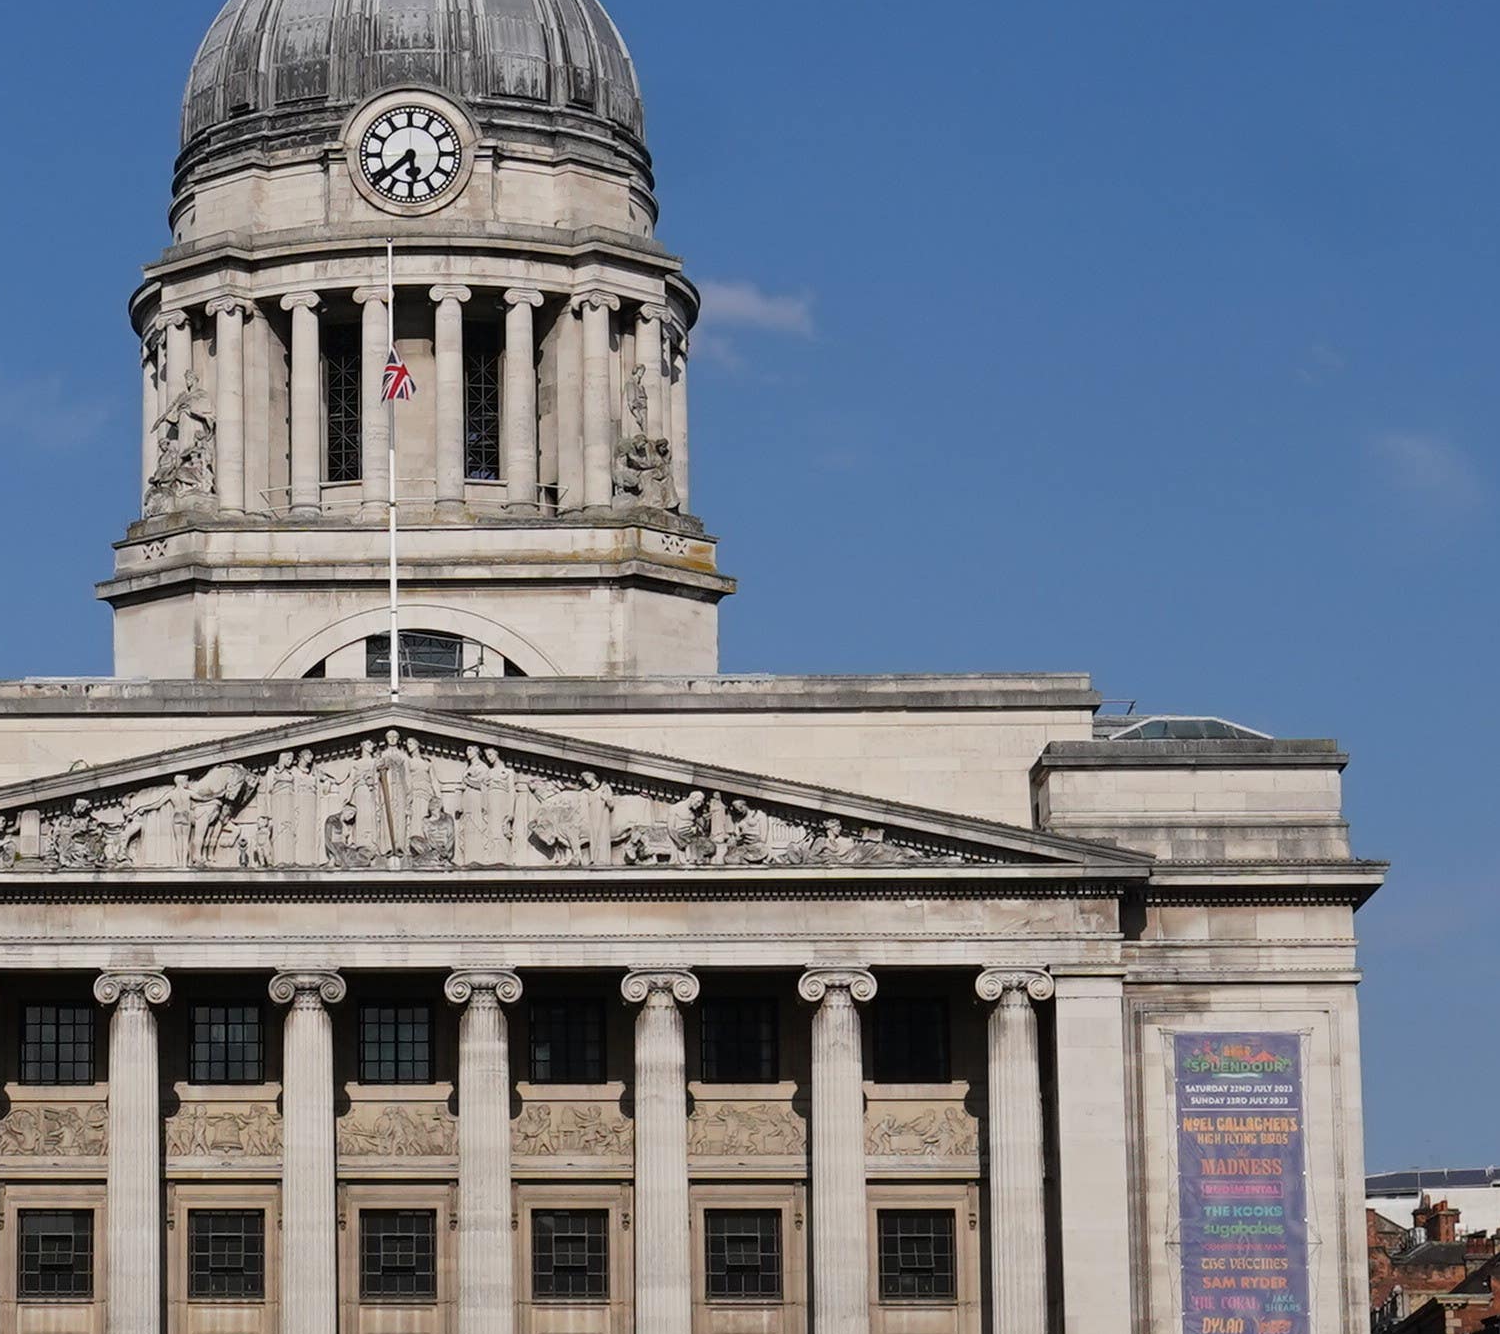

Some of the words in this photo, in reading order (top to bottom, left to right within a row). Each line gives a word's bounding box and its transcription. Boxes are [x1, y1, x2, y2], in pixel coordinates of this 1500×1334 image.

[1190, 1061, 1285, 1073] SPLENDOUR
[1185, 1084, 1228, 1093] SATURDAY
[1253, 1085, 1272, 1093] JULY
[1190, 1097, 1225, 1105] SUNDAY
[1201, 1158, 1282, 1175] MADNESS
[1203, 1205, 1230, 1217] THE
[1233, 1205, 1283, 1217] KOOKS
[1202, 1276, 1237, 1289] SAM
[1240, 1276, 1288, 1289] RYDER
[1201, 1317, 1245, 1334] DYLAN
